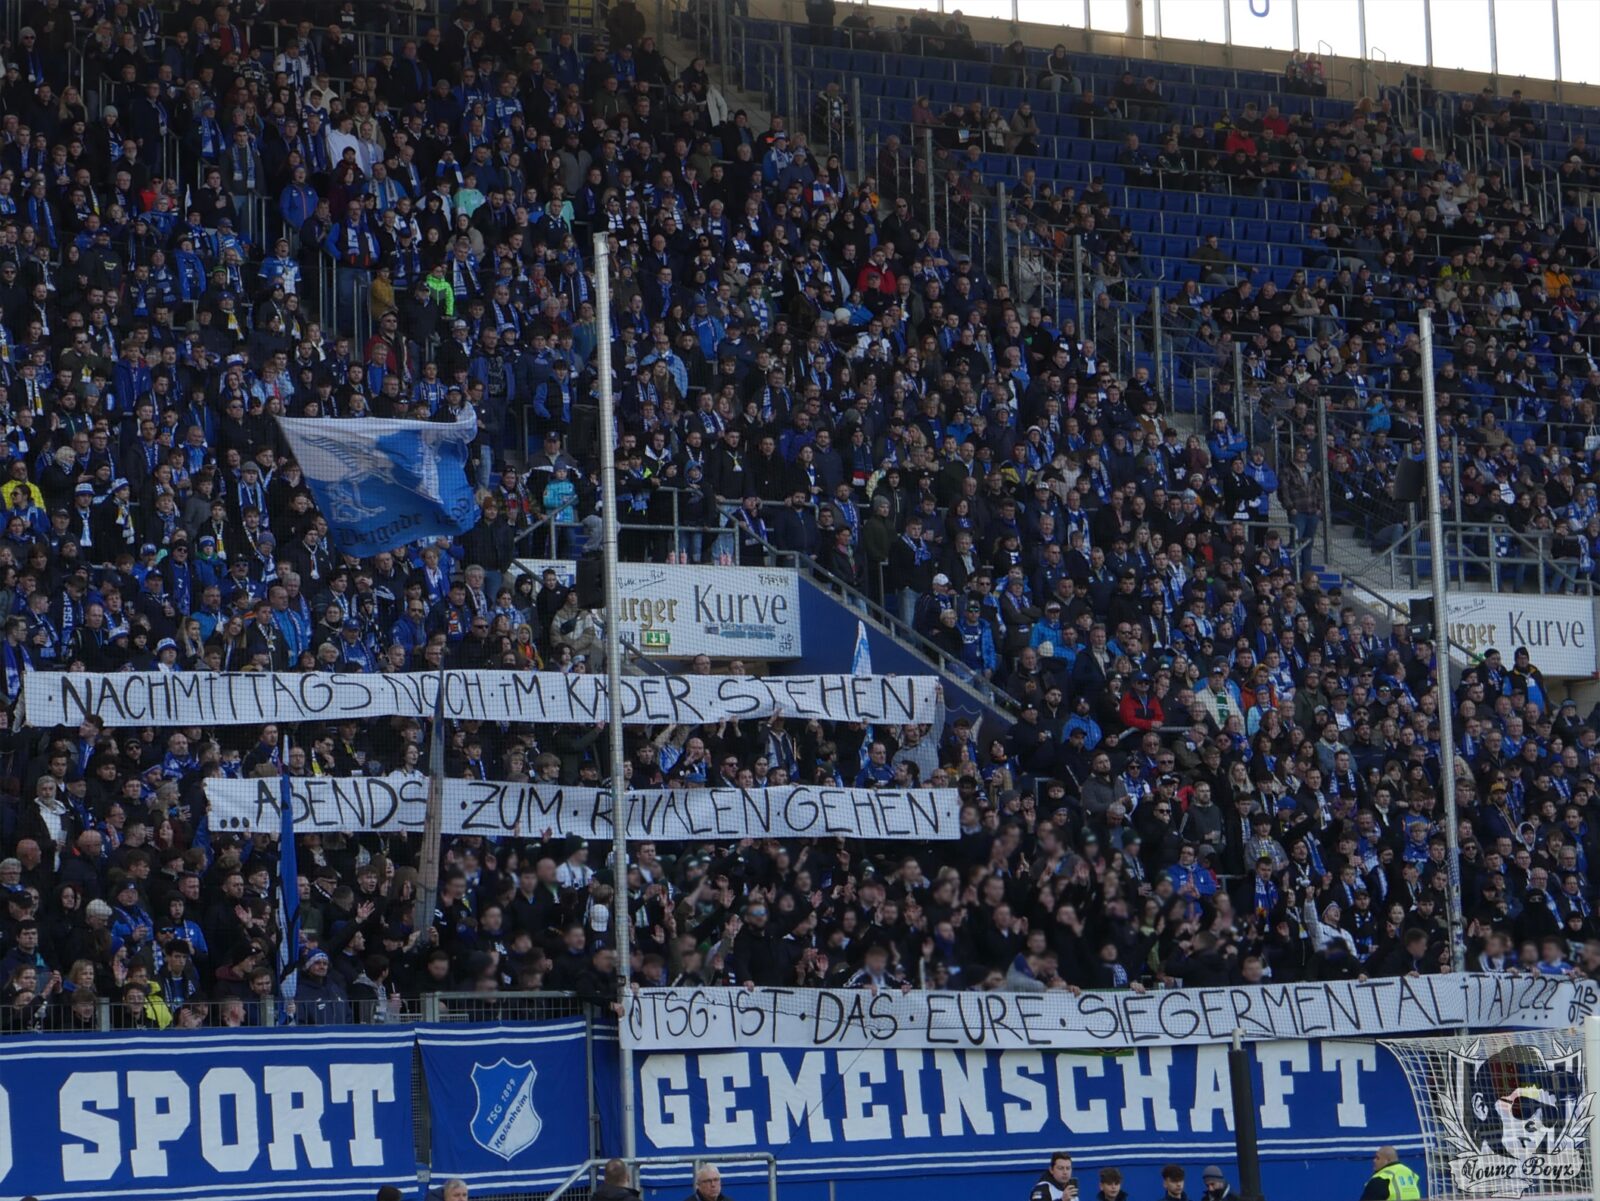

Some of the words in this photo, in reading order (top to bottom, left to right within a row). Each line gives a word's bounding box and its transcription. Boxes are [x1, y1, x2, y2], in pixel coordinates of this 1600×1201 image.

[62, 606, 73, 629] TSG
[694, 583, 788, 625] Kurve
[1508, 610, 1585, 649] Kurve
[381, 671, 488, 720] NOCH
[564, 673, 705, 721] KADER
[717, 675, 915, 720] STEHEN
[461, 781, 564, 834] ZUM
[783, 786, 940, 835] GEHEN
[727, 988, 793, 1043] IST
[814, 991, 899, 1044] DAS
[926, 994, 1051, 1045] EURE
[485, 1103, 503, 1125] TSG
[501, 1077, 517, 1102] 1899
[640, 1038, 1377, 1149] GEMEINSCHAFT
[59, 1062, 396, 1182] SPORT
